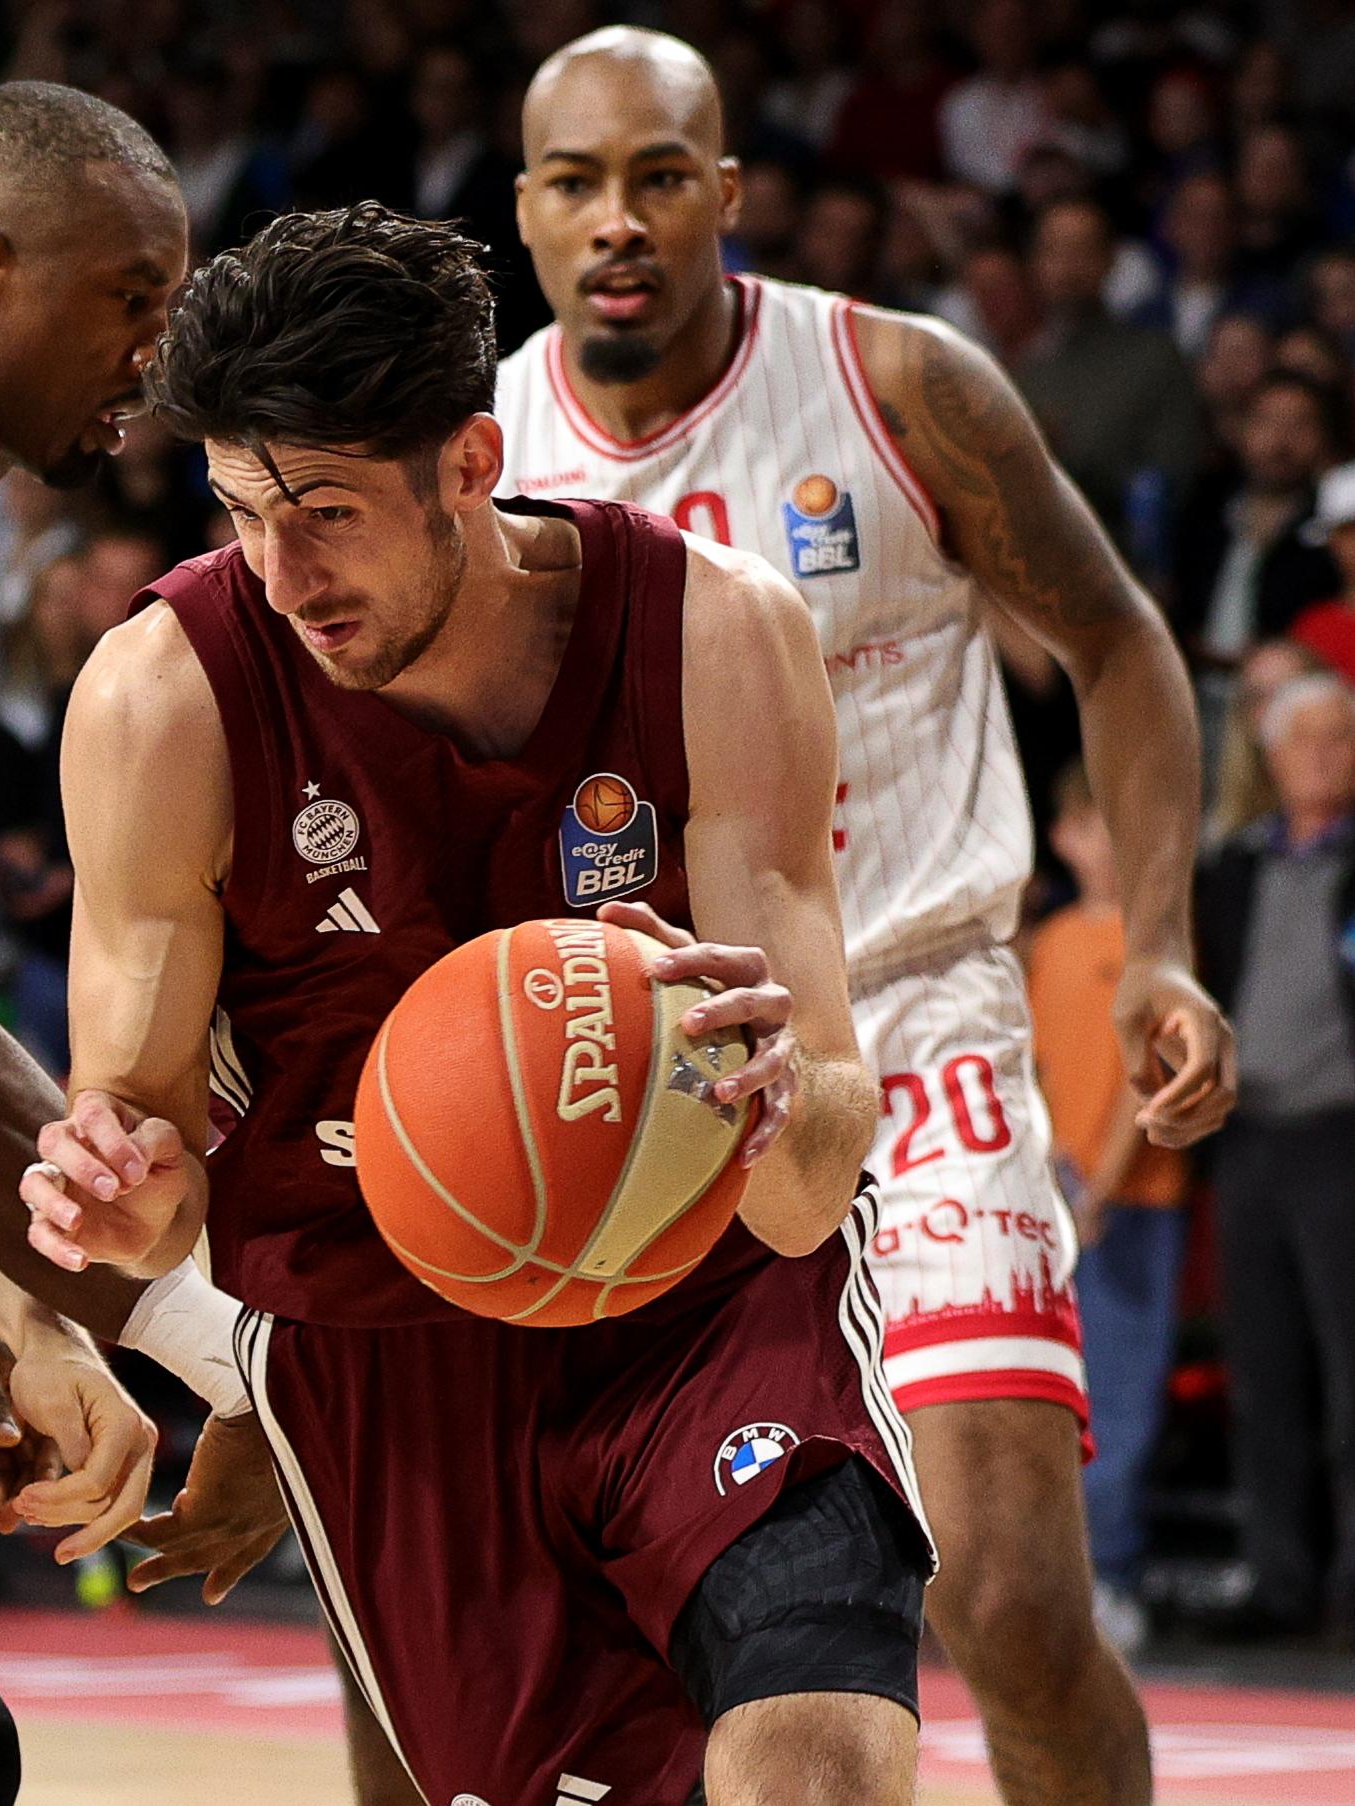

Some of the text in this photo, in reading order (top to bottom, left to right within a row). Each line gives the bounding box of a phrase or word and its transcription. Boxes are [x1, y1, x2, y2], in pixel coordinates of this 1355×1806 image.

[798, 544, 855, 573] BBL
[297, 804, 351, 836] FC BAYERN
[305, 855, 368, 885] BASKETBALL
[594, 848, 646, 867] Credit
[576, 862, 645, 896] BBL
[880, 1055, 1012, 1178] 20
[315, 1120, 357, 1167] S
[722, 1427, 786, 1461] BMW
